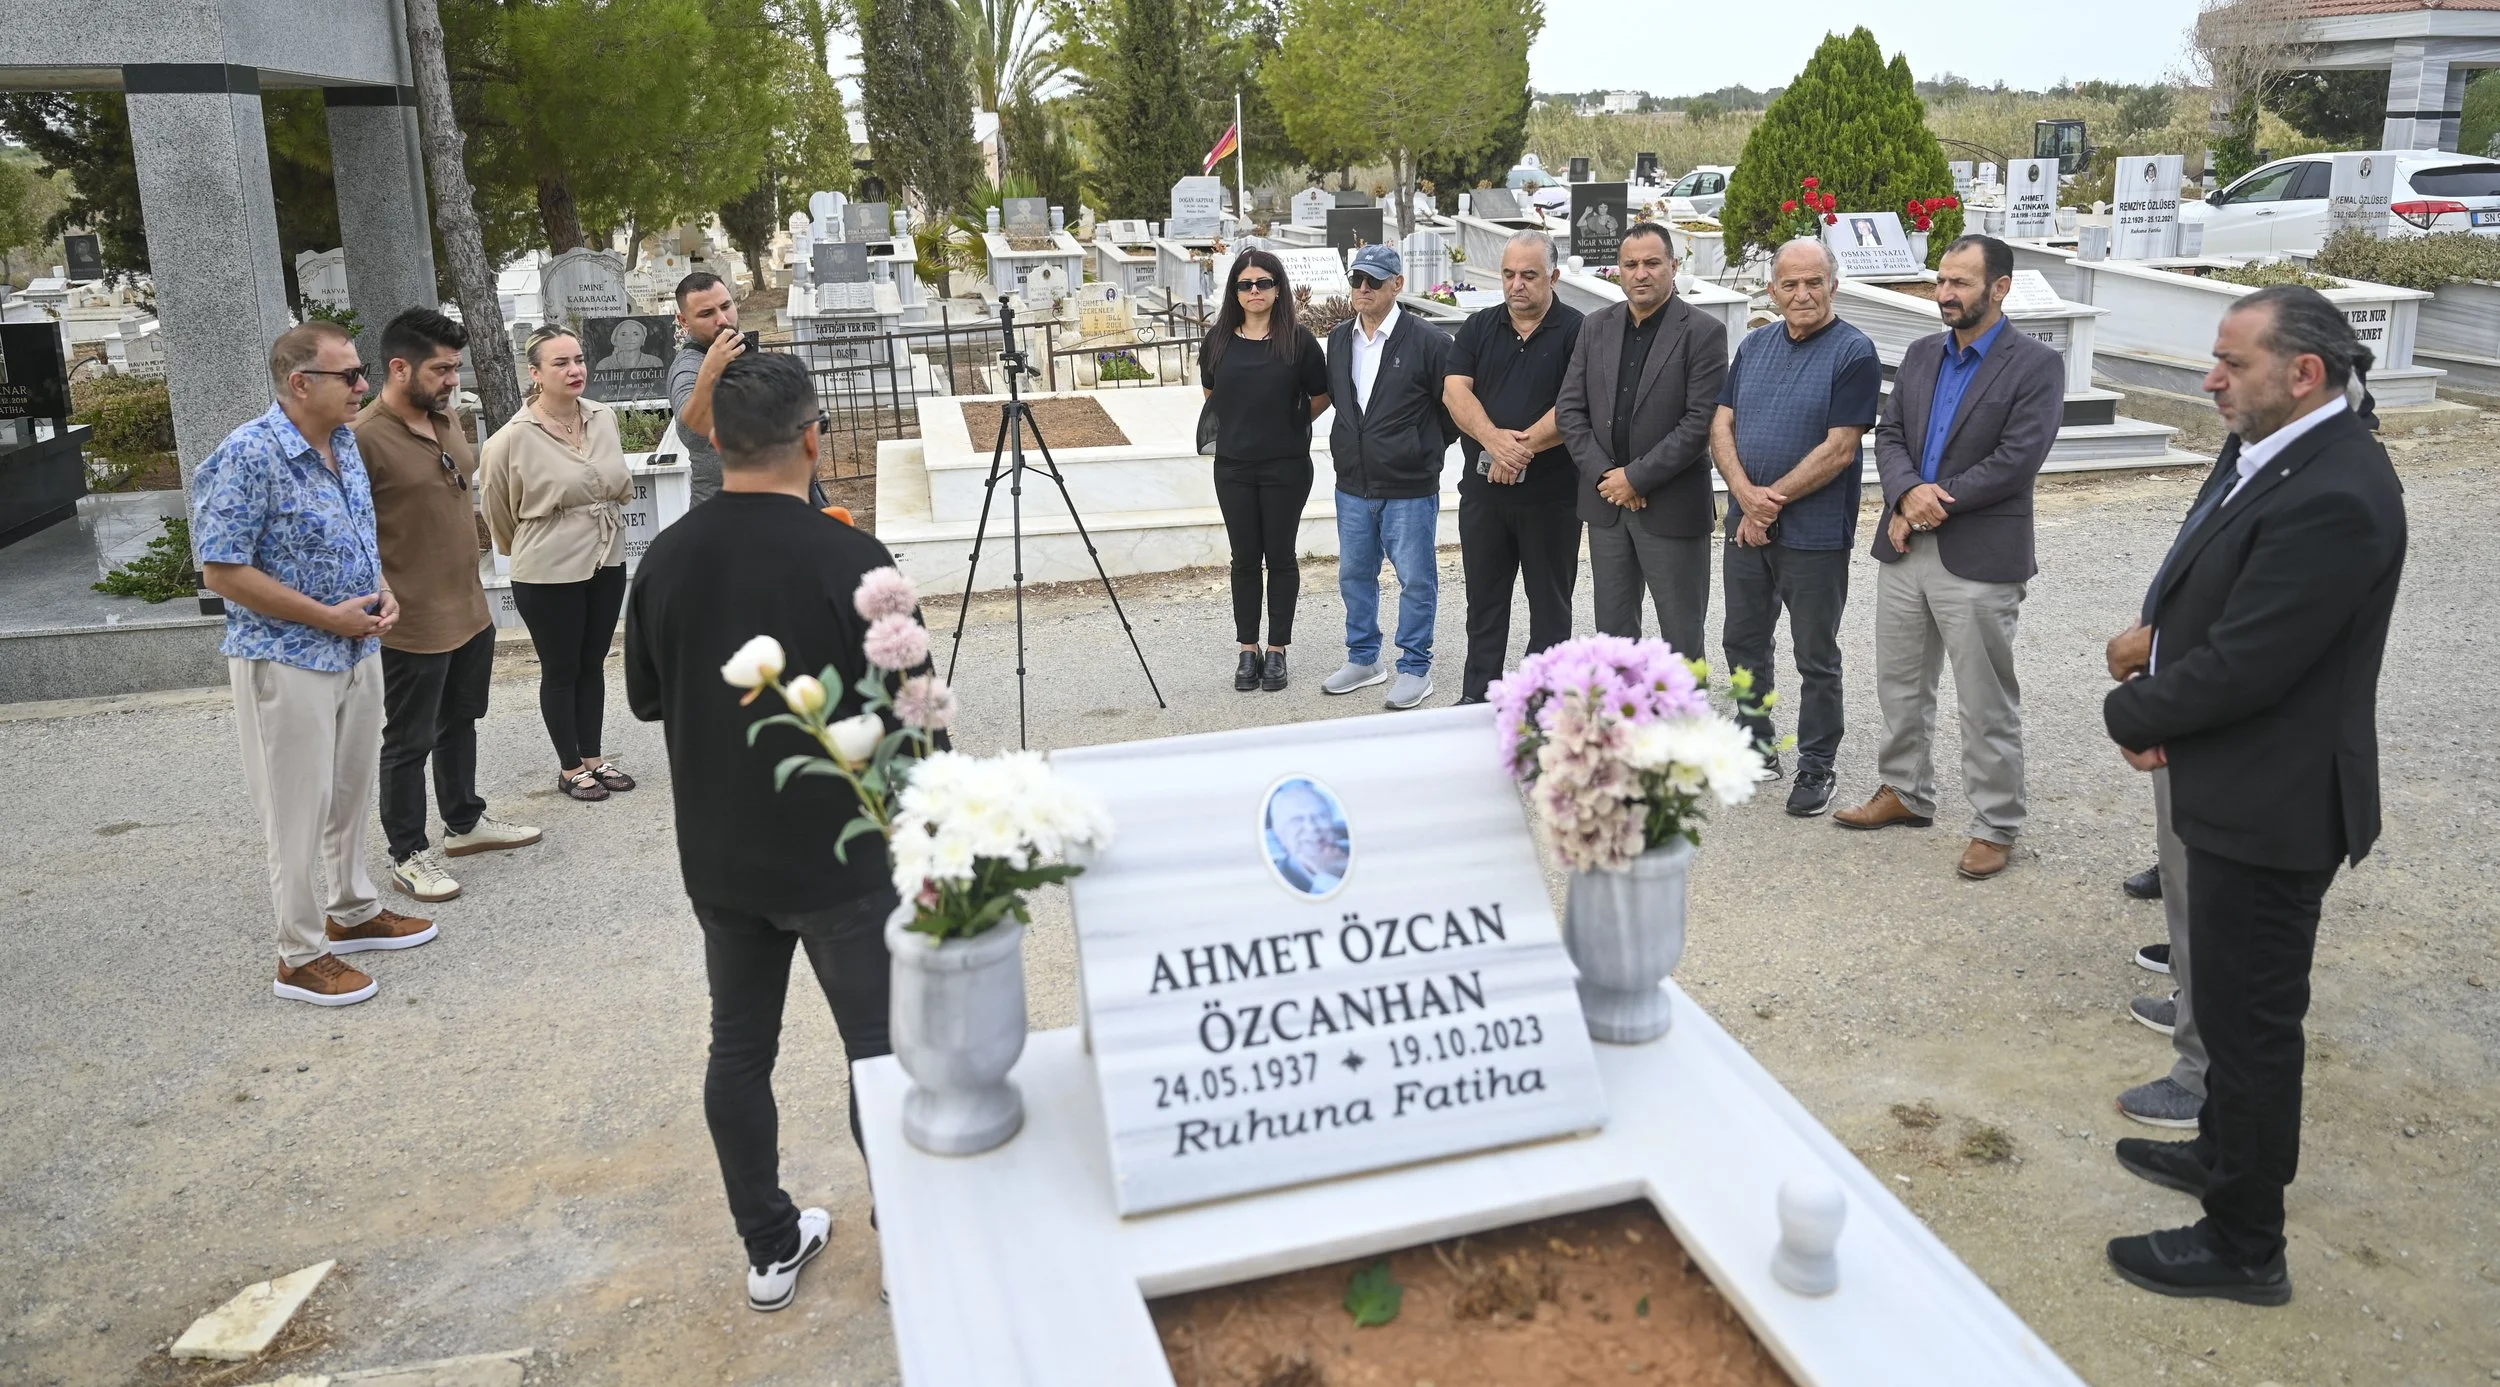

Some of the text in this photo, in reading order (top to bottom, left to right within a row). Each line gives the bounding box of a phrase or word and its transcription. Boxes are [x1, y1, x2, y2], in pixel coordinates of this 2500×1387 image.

[2020, 194, 2044, 202] AHMET
[2336, 194, 2388, 205] KEMAL ÖZLÜSES
[2012, 203, 2050, 211] ALTINKAYA
[2119, 198, 2176, 212] REMZİYE ÖZLÜSES
[2485, 213, 2496, 223] SN
[1840, 250, 1872, 258] OSMAN
[2351, 310, 2368, 323] YER
[2369, 309, 2386, 322] NUR
[2038, 332, 2054, 342] NUR
[2353, 328, 2383, 341] ENNET
[593, 371, 625, 382] ZALİHE
[1148, 903, 1508, 995] AHMET ÖZCAN
[1199, 971, 1488, 1055] ÖZCANHAN
[1153, 1014, 1544, 1110] 24.05.1937 19.10.2023
[1172, 1065, 1547, 1157] Ruhuna Fatiha
